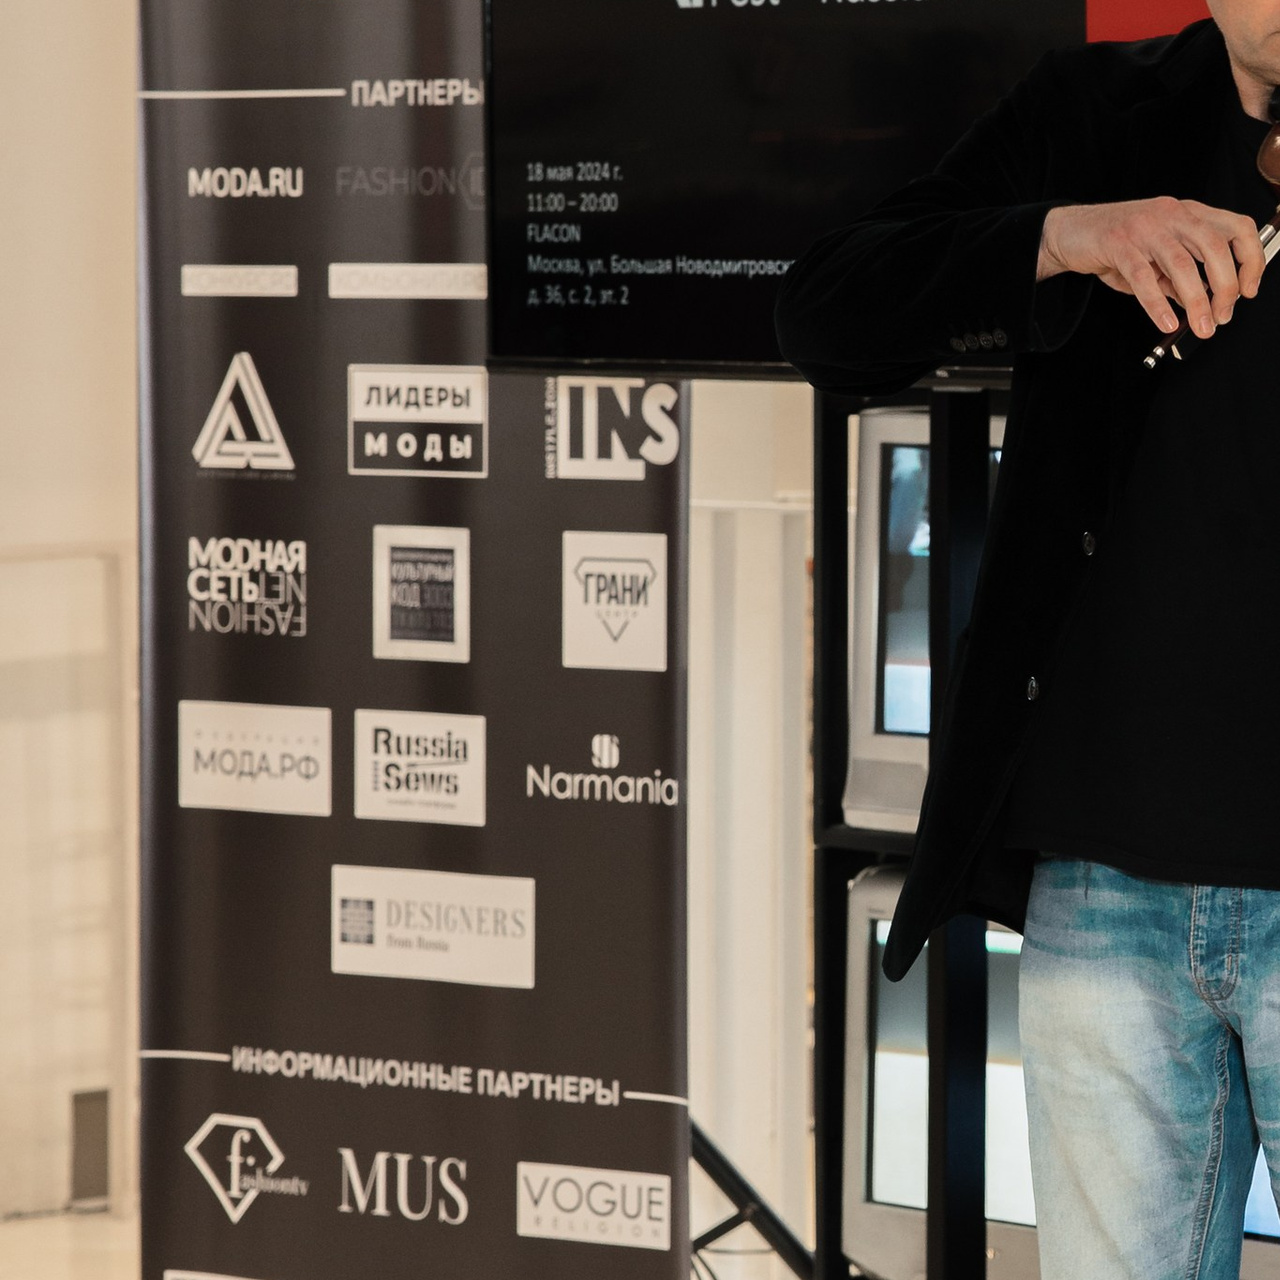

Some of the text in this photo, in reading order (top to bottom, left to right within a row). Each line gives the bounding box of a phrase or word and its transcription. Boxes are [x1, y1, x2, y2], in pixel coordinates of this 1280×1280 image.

[351, 78, 485, 108] ПАРТНЕРЫ
[188, 167, 304, 198] MODA.RU
[335, 166, 457, 196] FASHION
[527, 161, 544, 181] 18
[546, 165, 574, 181] мая
[576, 161, 610, 181] 2024
[527, 192, 566, 213] 11:00
[579, 192, 619, 213] 20:00
[527, 223, 582, 243] FLACON
[527, 254, 585, 276] Москва,
[610, 254, 673, 275] Большая
[619, 284, 630, 305] 2
[365, 385, 471, 410] ЛИДЕРЫ
[364, 431, 472, 463] МОДЫ
[187, 567, 259, 603] СЕТЬ
[584, 573, 648, 605] ГРАНИ
[373, 727, 468, 761] Russia
[194, 747, 320, 782] МОДА.РФ
[526, 764, 679, 806] Narmania
[386, 899, 527, 938] DESIGNERS
[232, 1045, 620, 1107] ИНФОРМАЦИОННЫЕ ПАРТНЕРЫ
[337, 1147, 469, 1226] MUS
[523, 1175, 664, 1222] VOGUE
